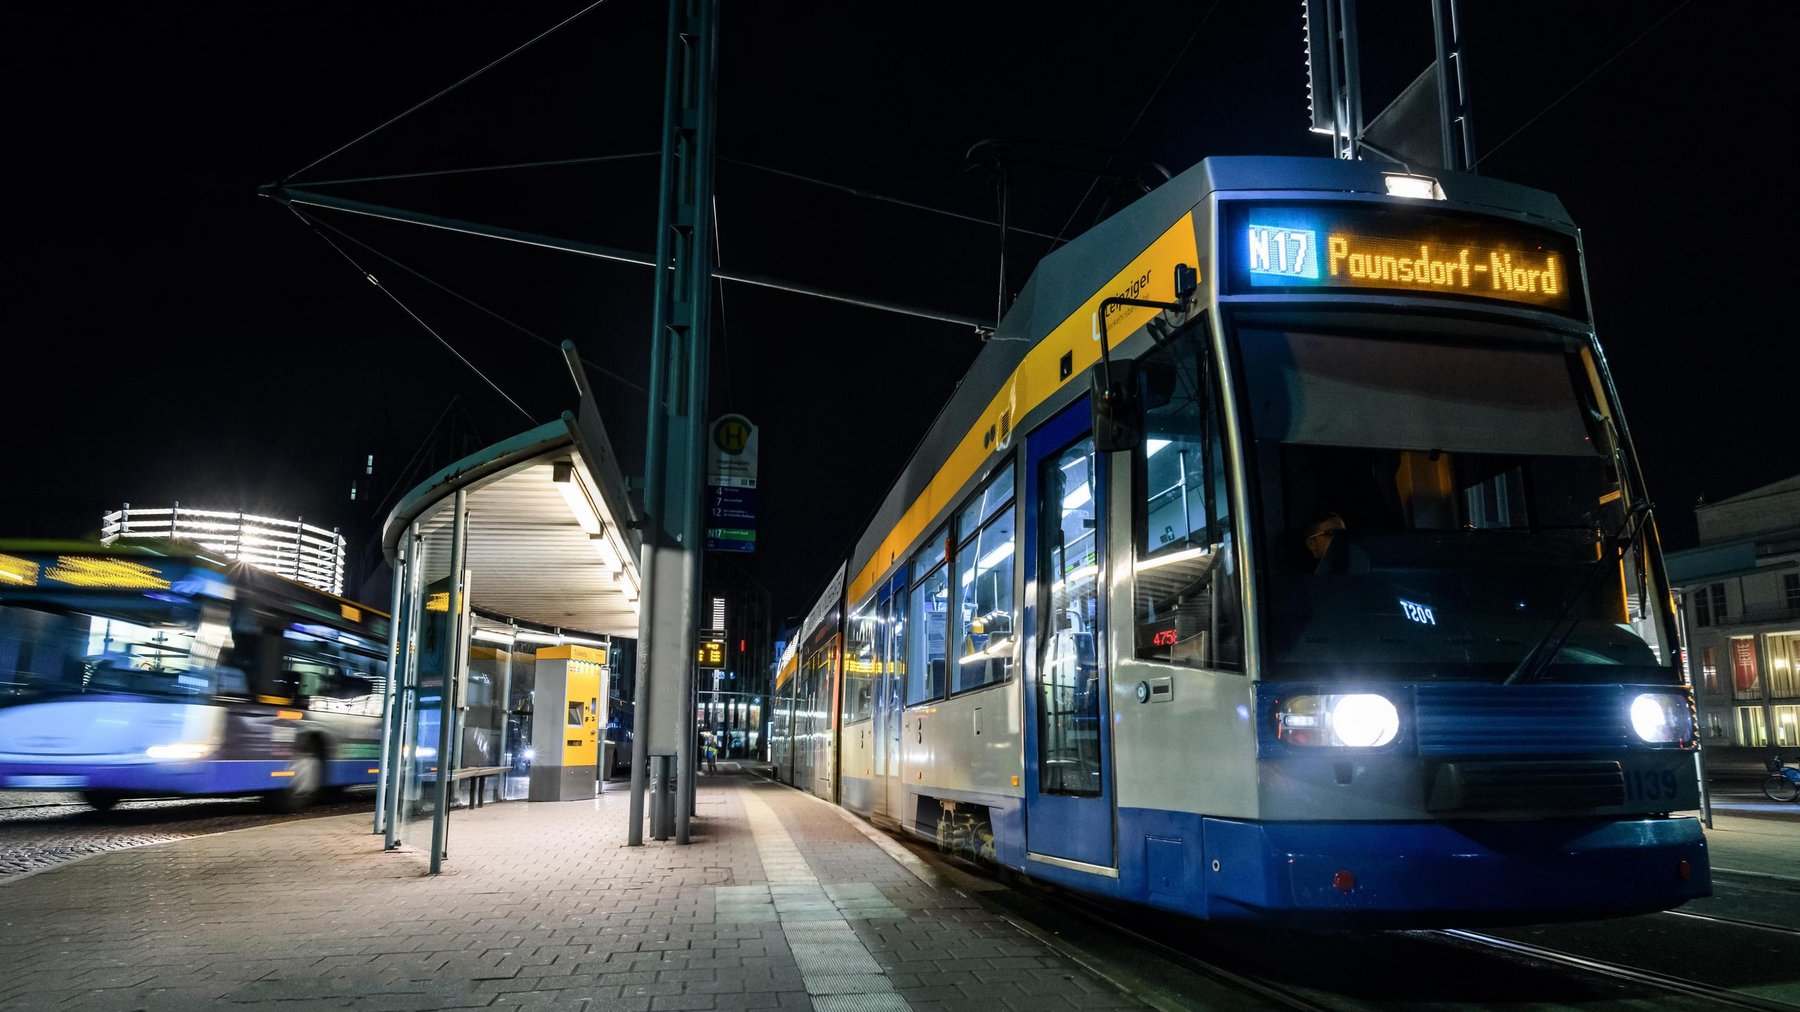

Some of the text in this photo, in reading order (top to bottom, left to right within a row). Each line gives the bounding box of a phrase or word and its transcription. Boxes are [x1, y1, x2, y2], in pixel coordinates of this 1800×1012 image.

[1249, 229, 1560, 295] N17 Paunsdorf-Nord
[1104, 269, 1152, 318] Leipziger
[726, 425, 742, 447] H
[716, 487, 723, 497] 4
[716, 497, 723, 506] 7
[711, 507, 722, 517] 12
[708, 528, 722, 539] N17
[1737, 642, 1751, 667] HEUTE
[1624, 770, 1678, 801] 1139
